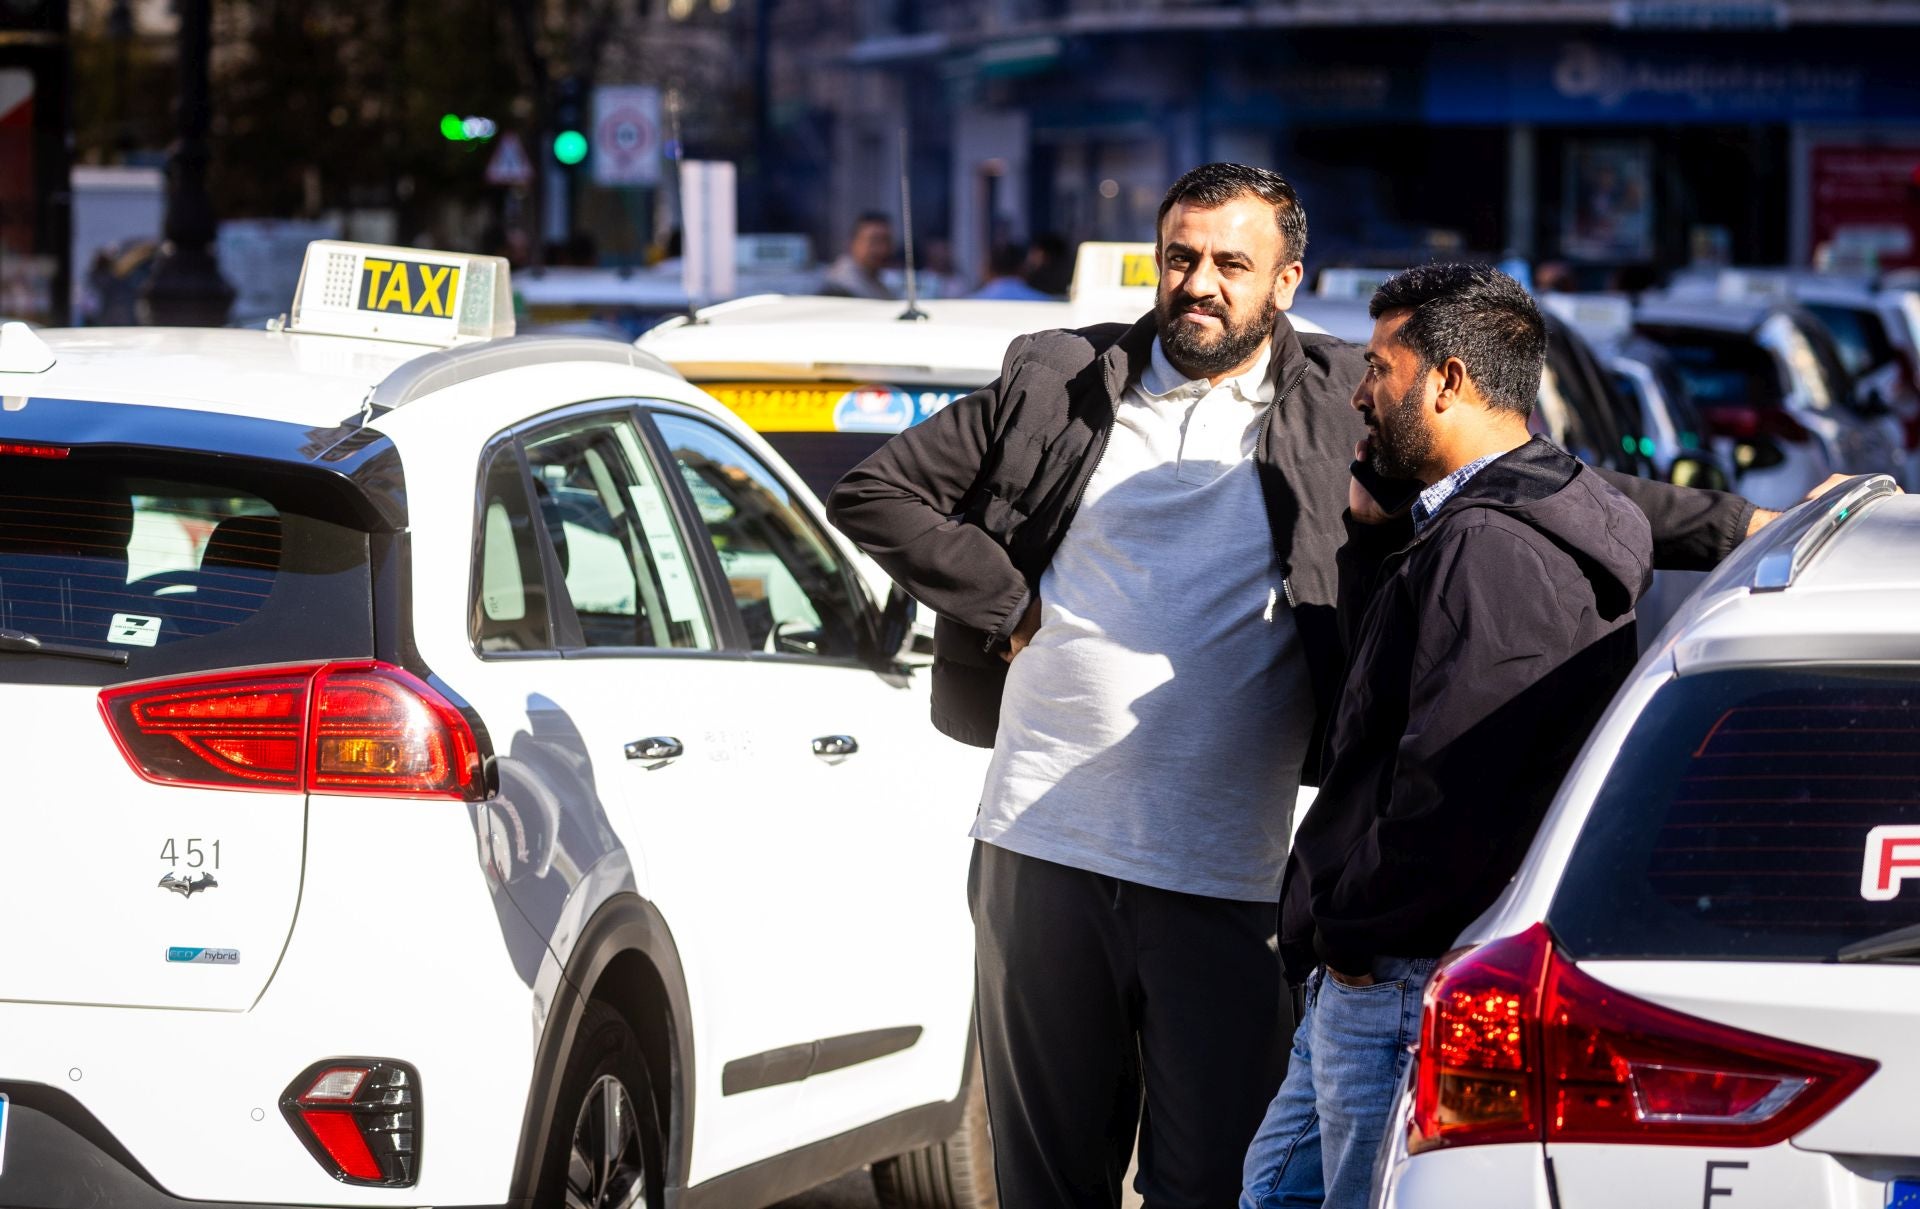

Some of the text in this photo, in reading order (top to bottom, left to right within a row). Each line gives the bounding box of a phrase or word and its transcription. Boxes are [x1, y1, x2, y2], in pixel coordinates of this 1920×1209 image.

[1123, 254, 1158, 287] TA
[363, 259, 461, 317] TAXI
[159, 838, 221, 869] 451
[204, 950, 238, 961] hybrid
